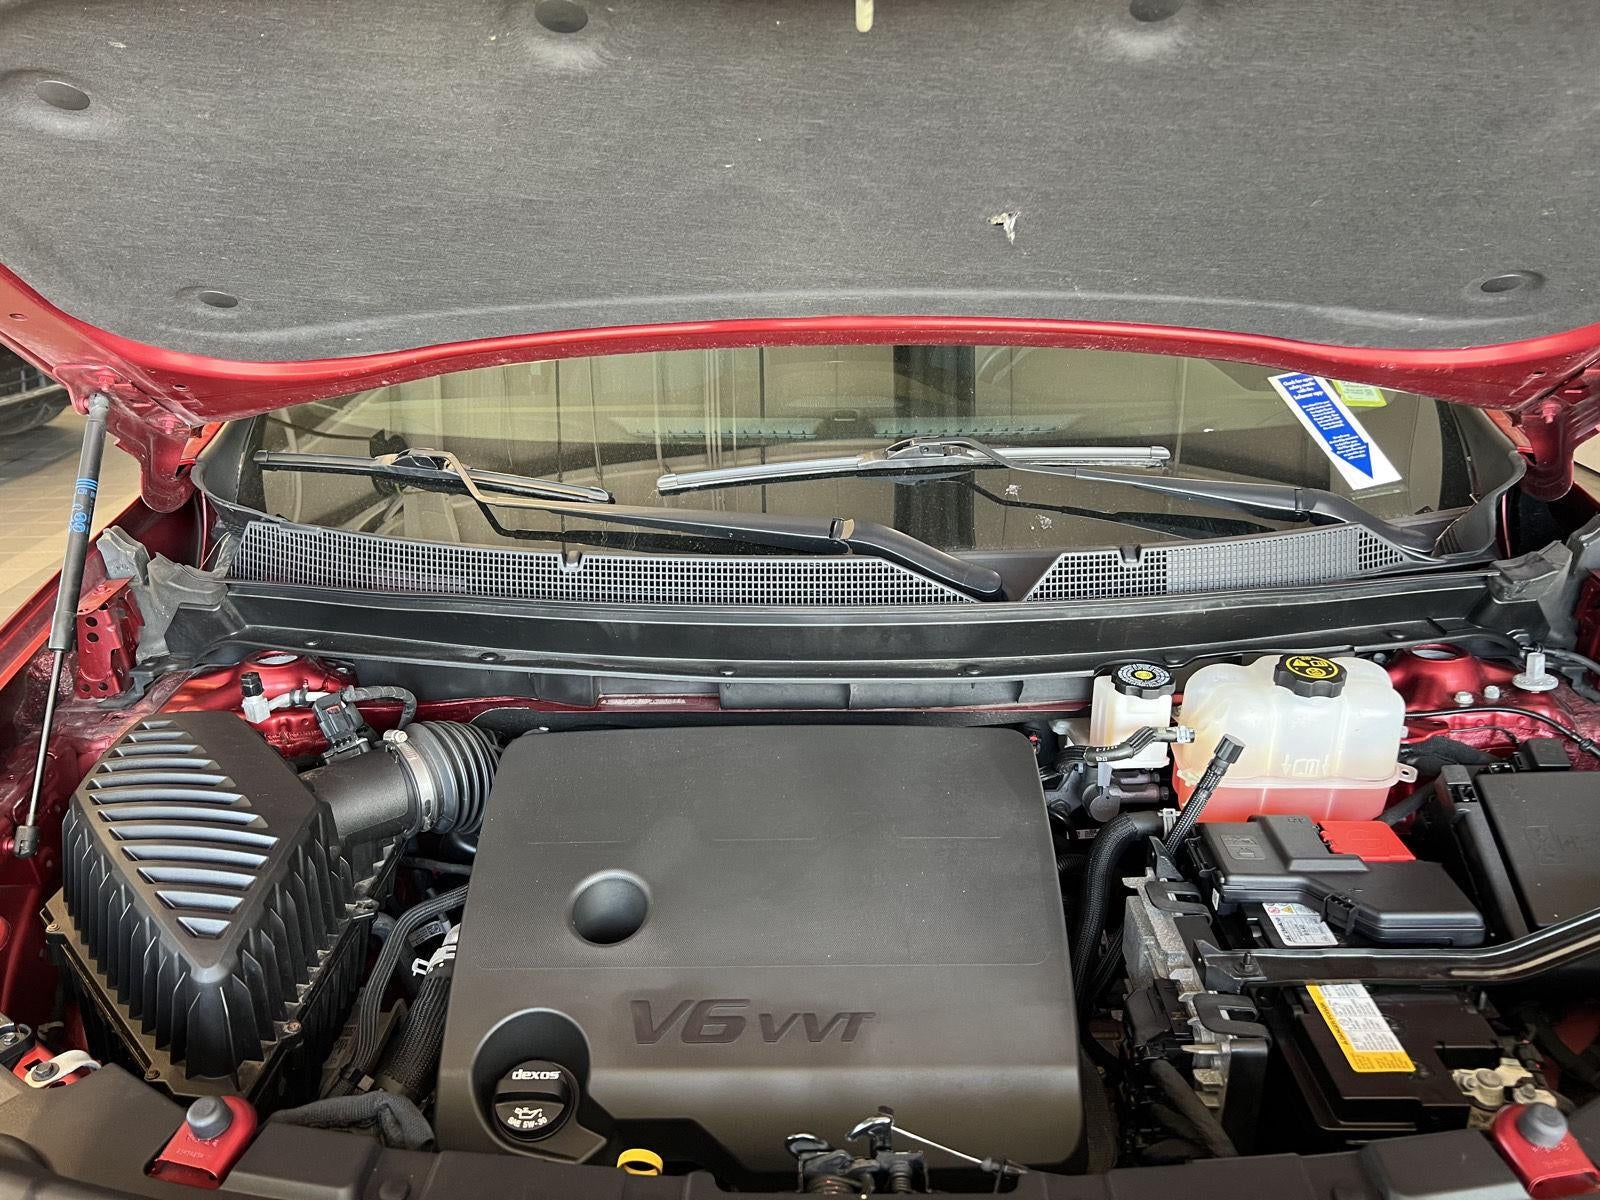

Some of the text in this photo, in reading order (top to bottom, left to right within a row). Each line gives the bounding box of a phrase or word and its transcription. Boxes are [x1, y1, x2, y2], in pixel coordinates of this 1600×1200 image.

[630, 998, 877, 1044] V6 VVT
[511, 1068, 562, 1080] dexos
